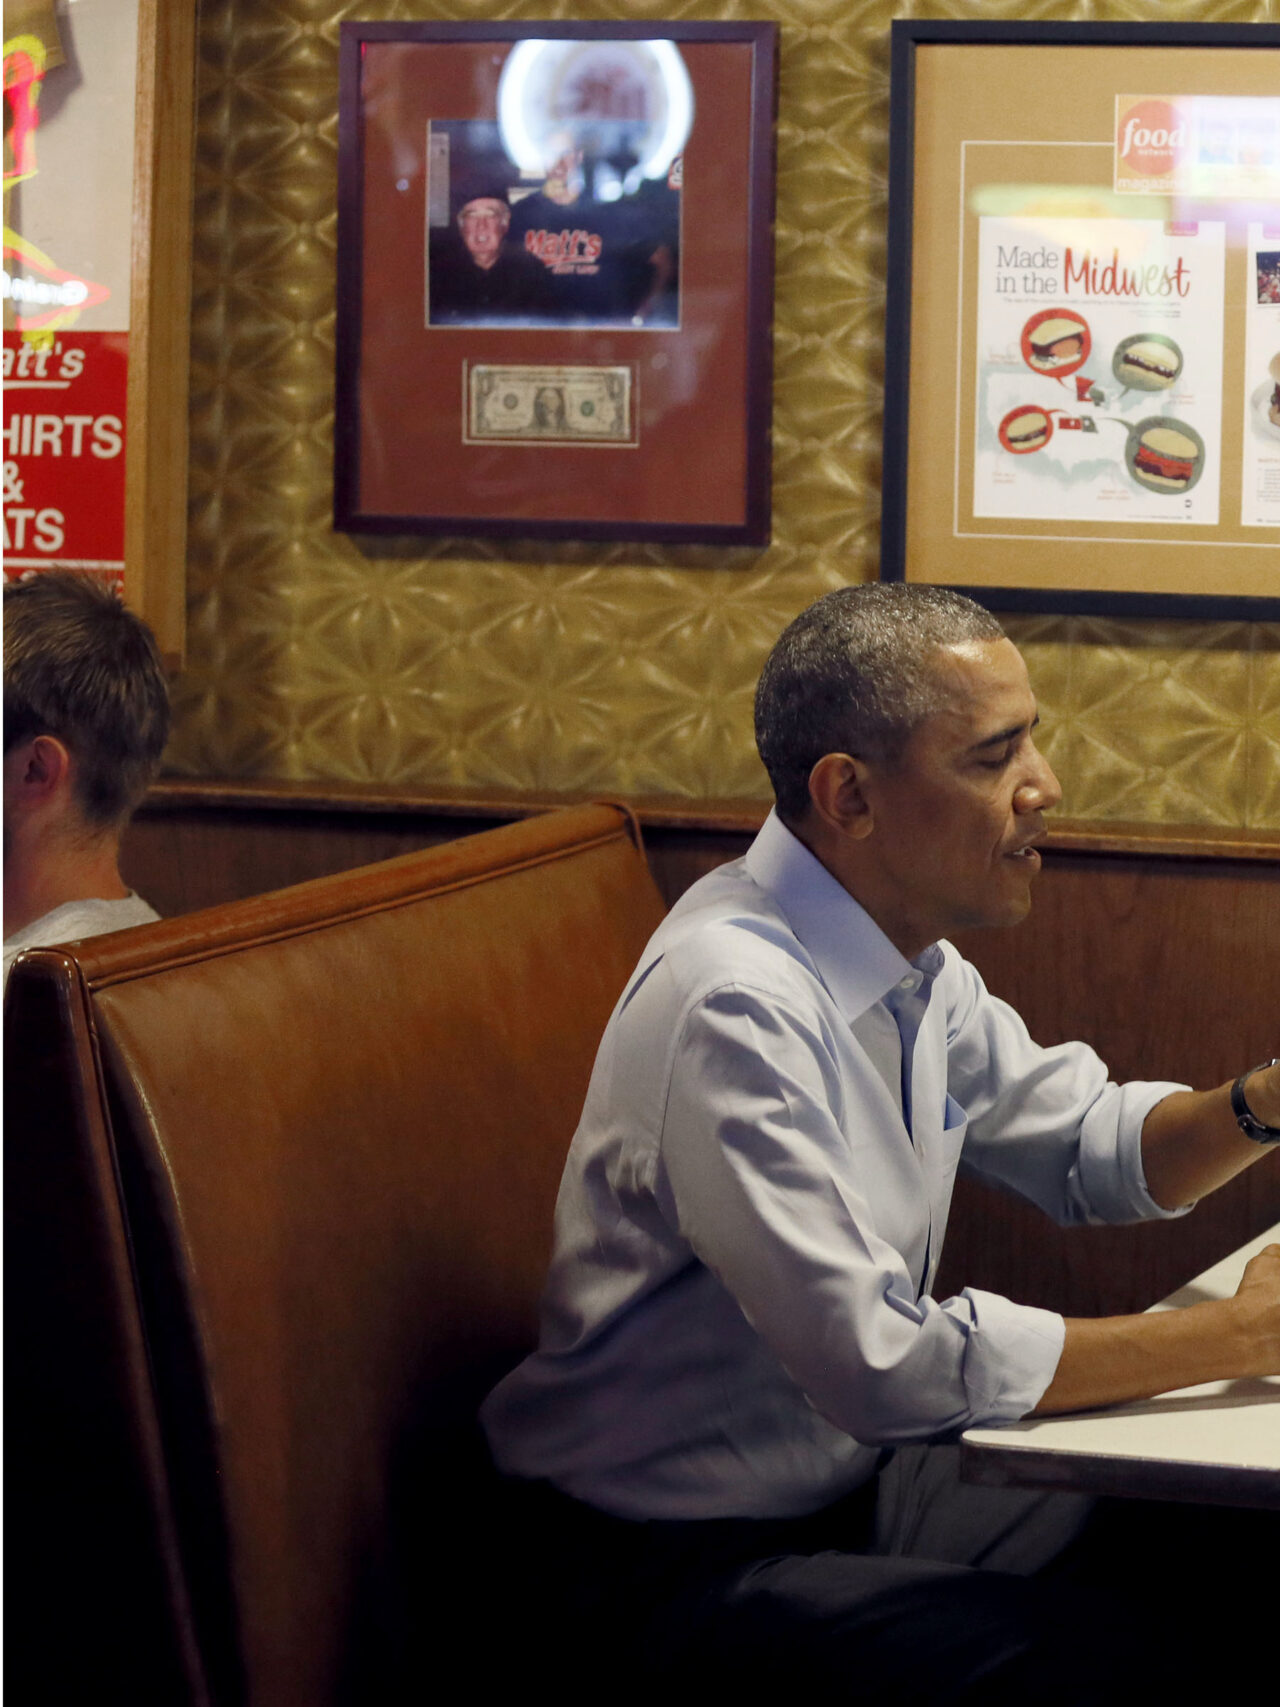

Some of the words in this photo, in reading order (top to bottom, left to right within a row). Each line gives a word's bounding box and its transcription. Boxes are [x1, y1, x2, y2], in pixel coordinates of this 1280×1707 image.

[1121, 117, 1186, 158] food
[525, 230, 602, 258] Matt's
[997, 246, 1059, 269] Made
[996, 272, 1017, 294] in
[1023, 272, 1058, 295] the
[1064, 247, 1191, 298] Midwest
[3, 341, 86, 379] att's
[3, 413, 123, 459] HIRTS
